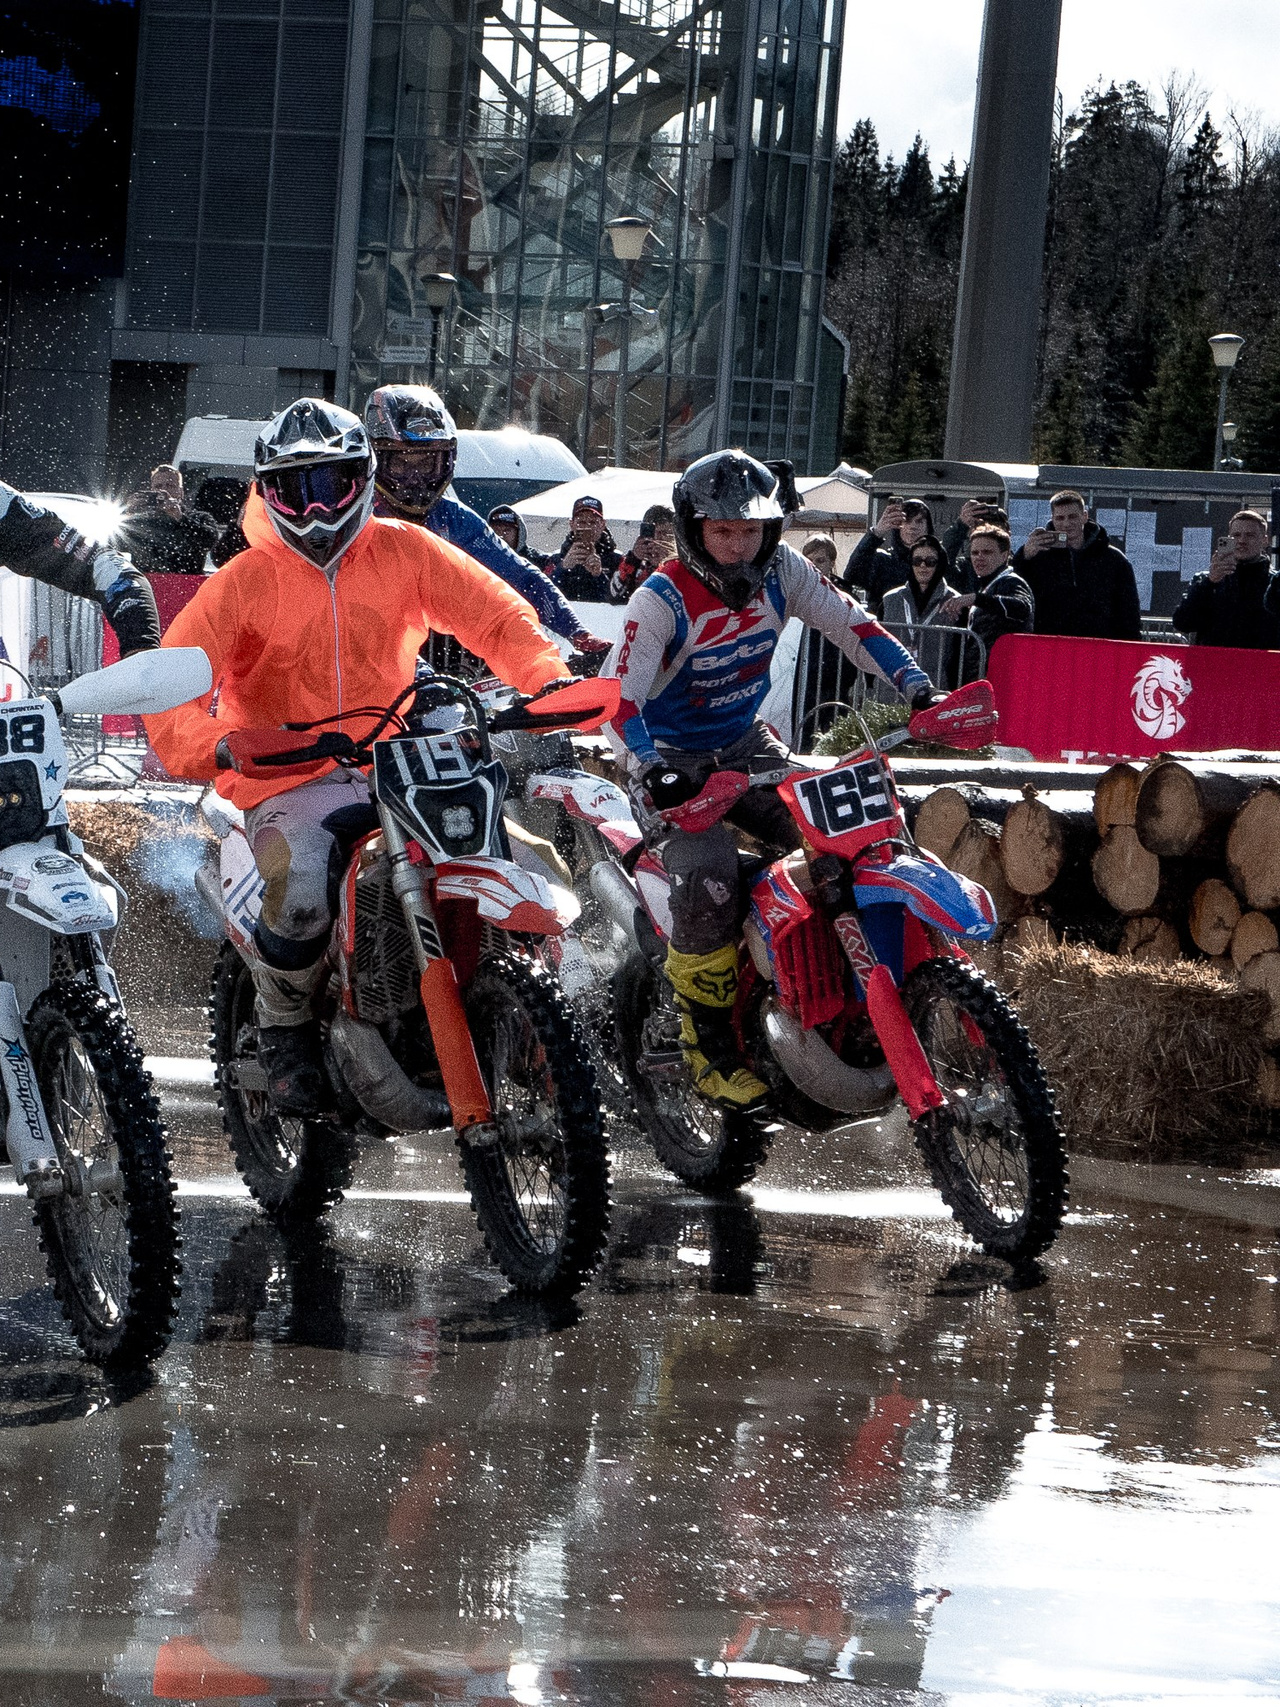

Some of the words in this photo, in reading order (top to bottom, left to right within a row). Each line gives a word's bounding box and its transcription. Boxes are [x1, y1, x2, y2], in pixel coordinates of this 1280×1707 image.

[616, 620, 639, 677] Bet
[692, 640, 773, 671] Beta
[710, 680, 764, 708] ROXO
[390, 735, 473, 786] 119
[800, 760, 895, 835] 165
